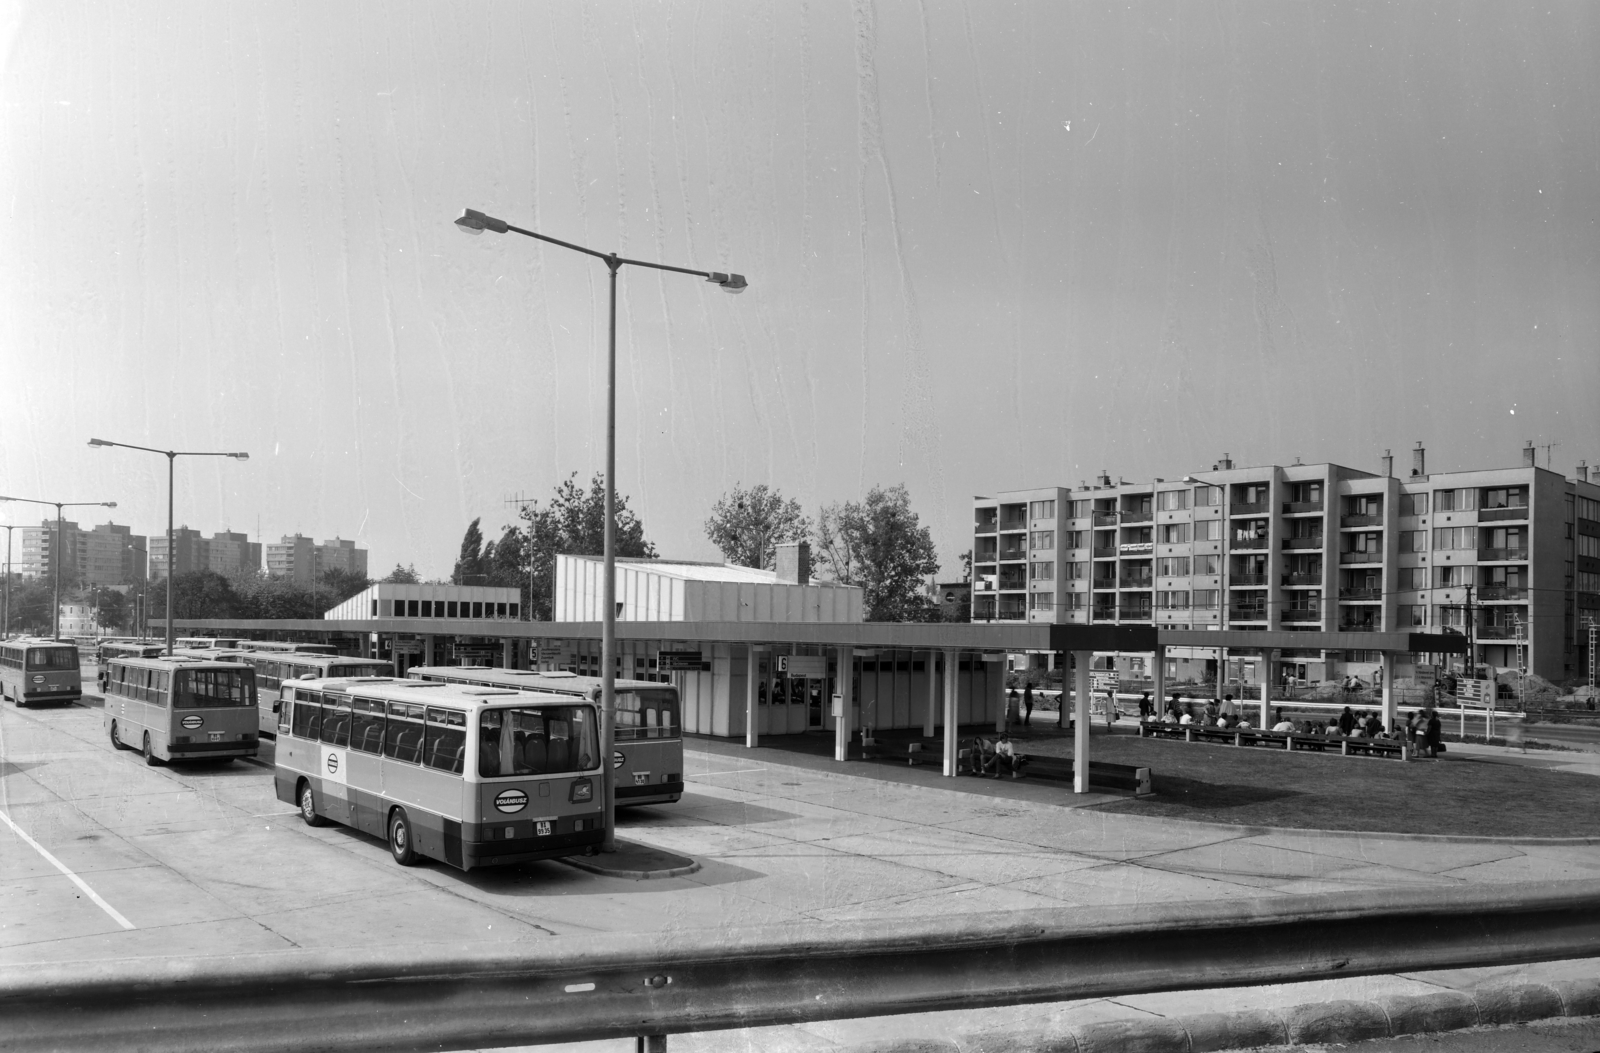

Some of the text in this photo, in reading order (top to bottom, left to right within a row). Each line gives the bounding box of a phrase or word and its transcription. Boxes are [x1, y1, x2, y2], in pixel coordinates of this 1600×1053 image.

[531, 648, 537, 658] 5
[781, 657, 787, 670] 6
[496, 797, 527, 805] VOLÁNBUSZ
